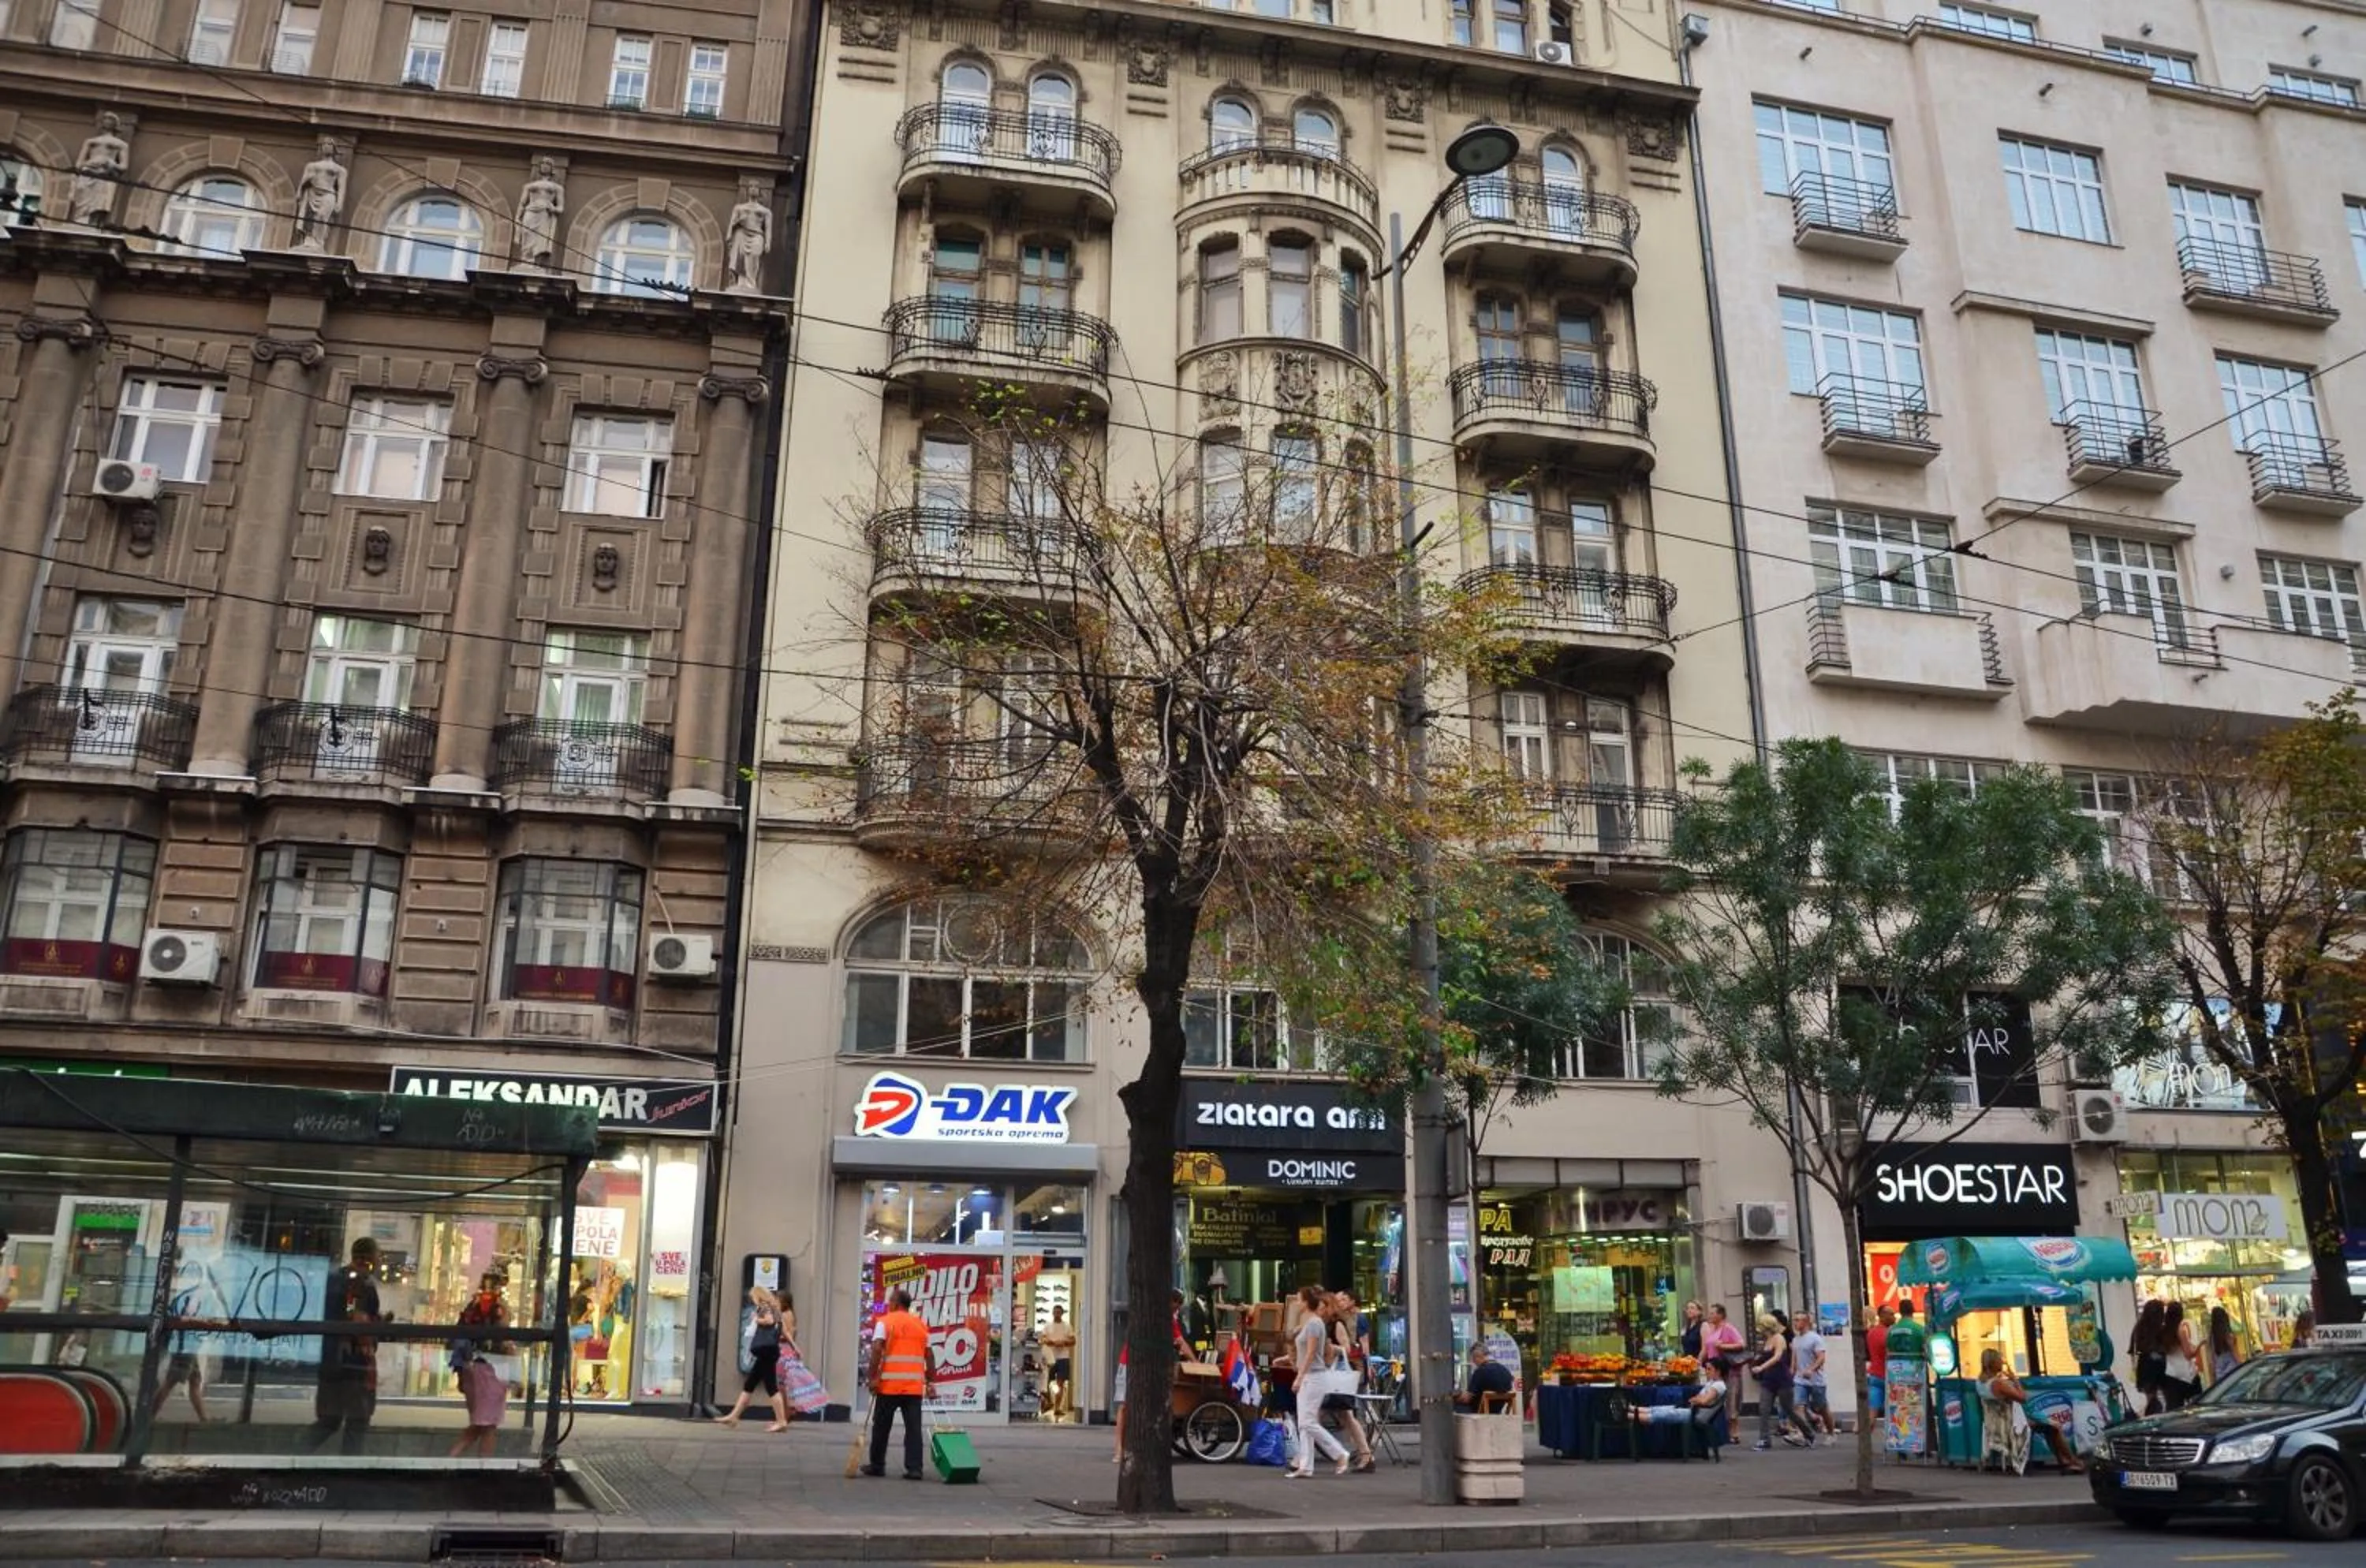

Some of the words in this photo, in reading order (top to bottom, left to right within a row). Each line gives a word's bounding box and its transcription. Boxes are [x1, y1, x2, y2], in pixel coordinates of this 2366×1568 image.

[1196, 1102, 1315, 1128] zlatara
[1009, 1129, 1064, 1139] oprema
[1268, 1159, 1356, 1179] DOMINIC
[1876, 1163, 2067, 1204] SHOESTAR
[575, 1226, 618, 1240] POLA
[574, 1239, 615, 1256] ENE
